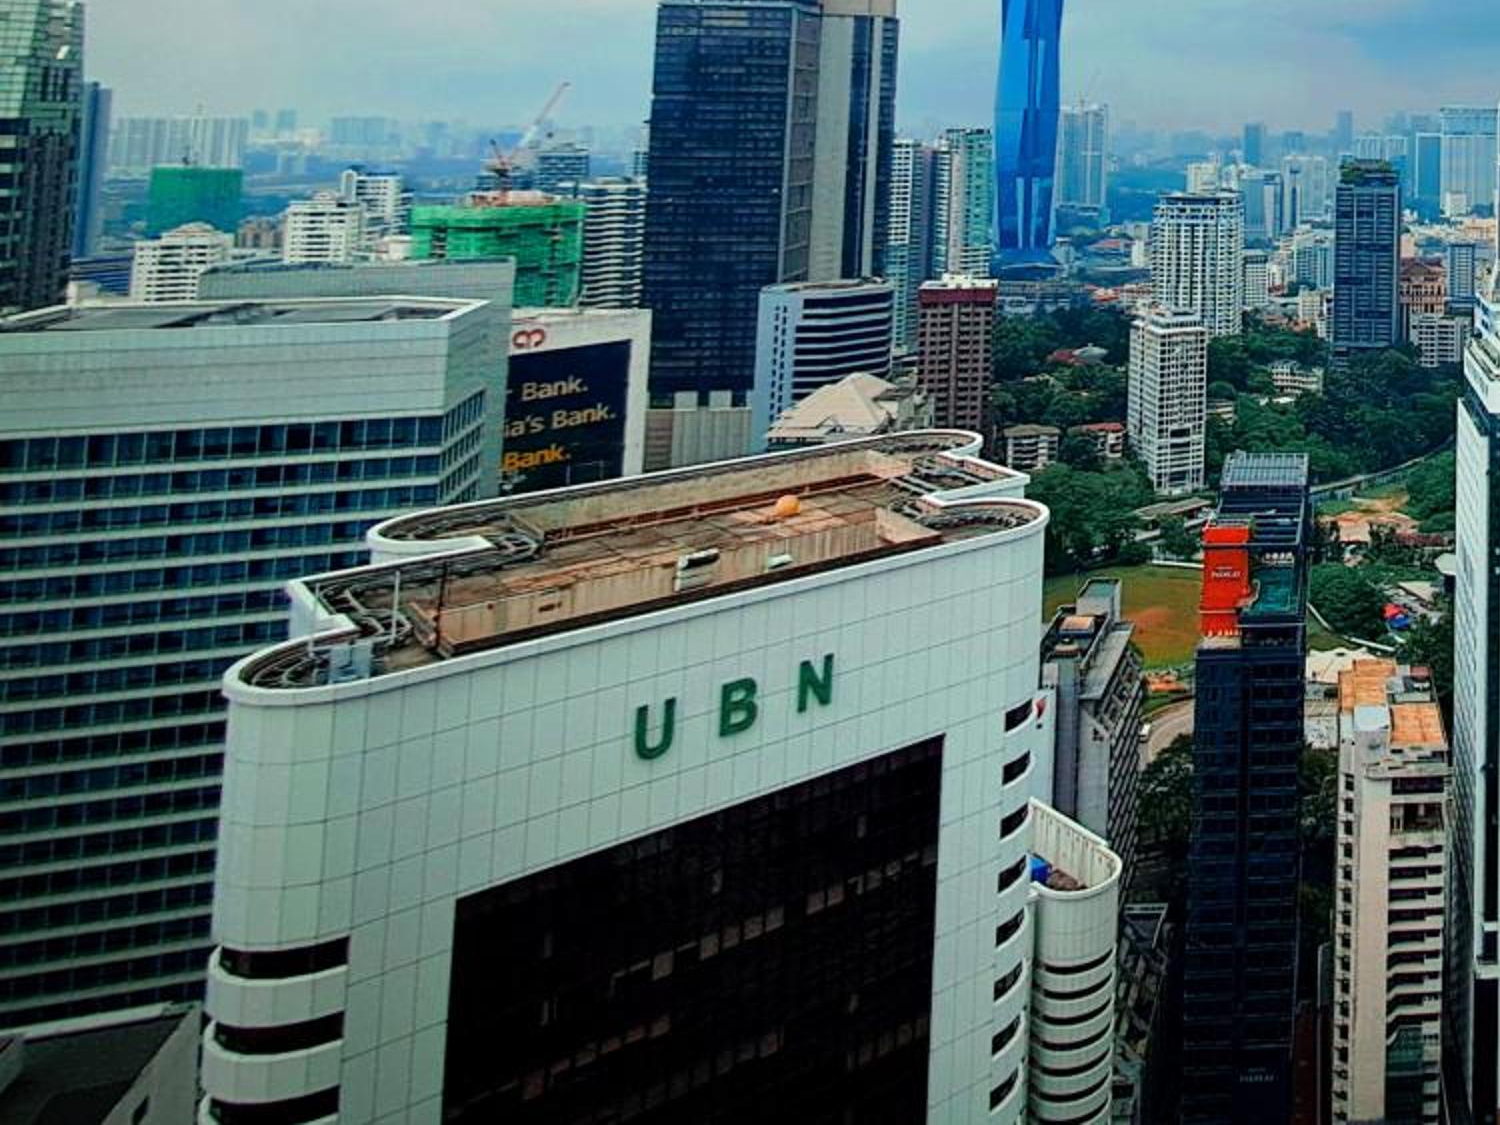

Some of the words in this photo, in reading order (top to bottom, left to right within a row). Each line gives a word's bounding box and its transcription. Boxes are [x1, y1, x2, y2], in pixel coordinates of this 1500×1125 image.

[521, 375, 589, 402] Bank.
[552, 403, 617, 429] Bank.
[635, 652, 835, 761] UBN
